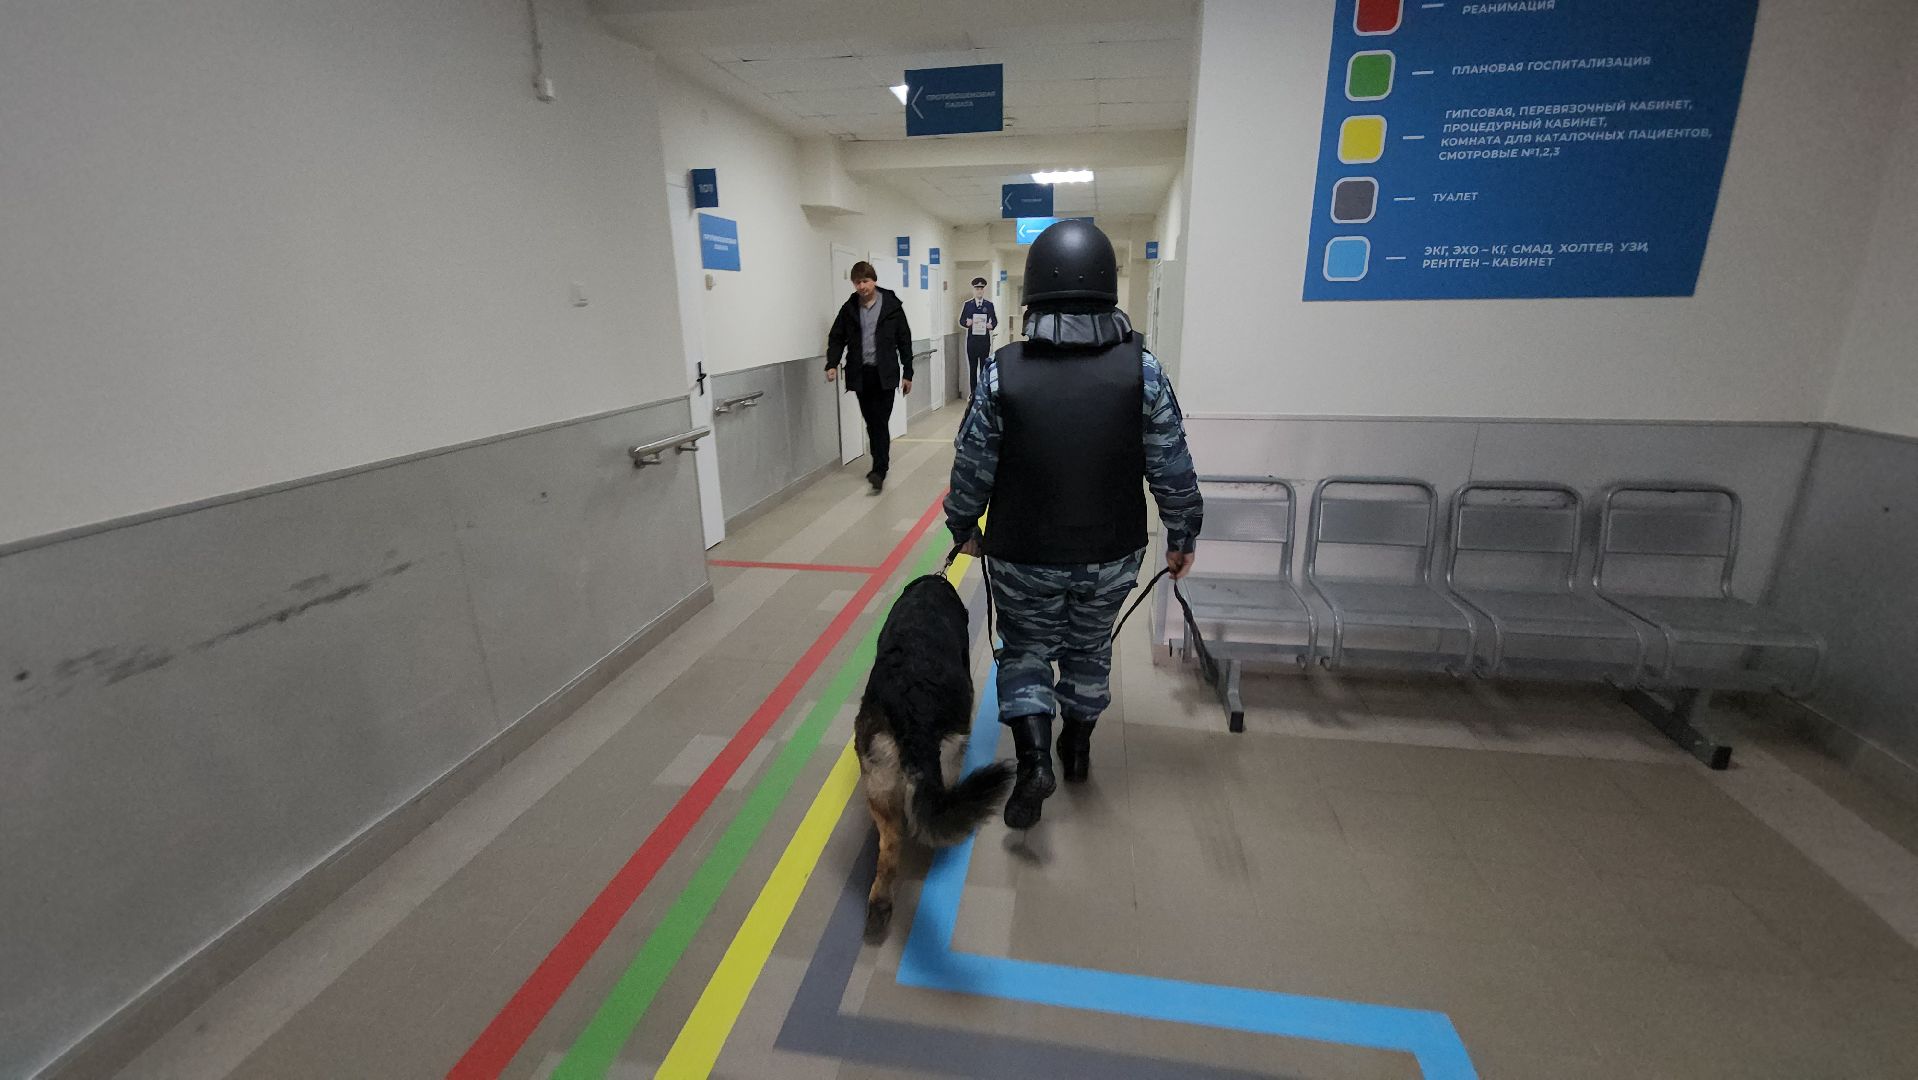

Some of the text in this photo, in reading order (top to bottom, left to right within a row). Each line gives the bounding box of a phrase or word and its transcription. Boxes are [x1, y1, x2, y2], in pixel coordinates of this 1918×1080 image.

[1462, 0, 1556, 14] РЕАНИМАЦИЯ
[1452, 56, 1652, 75] ПЛАНОВАЯ ГОСПИТАЛИЗАЦИЯ
[1445, 99, 1693, 119] ГИПСОВАЯ, ПЕРЕВЯЗОЧНЫЙ КАБИНЕТ,
[1443, 117, 1608, 133] ПРОЦЕДУРНЫЙ КАБИНЕТ,
[1440, 127, 1713, 147] КОМНАТА ДЛЯ КАТАЛОЧНЫХ ПАЦИЕНТОВ,
[1438, 148, 1519, 161] СМОТРОВЫЕ
[1432, 192, 1480, 203] ТУАЛЕТ
[1424, 245, 1450, 256] ЭКГ,
[1512, 244, 1554, 255] СМАД,
[1558, 242, 1615, 254] ХОЛТЕР,
[1422, 258, 1480, 269] РЕНТГЕН
[1492, 257, 1556, 268] КАБИНЕТ
